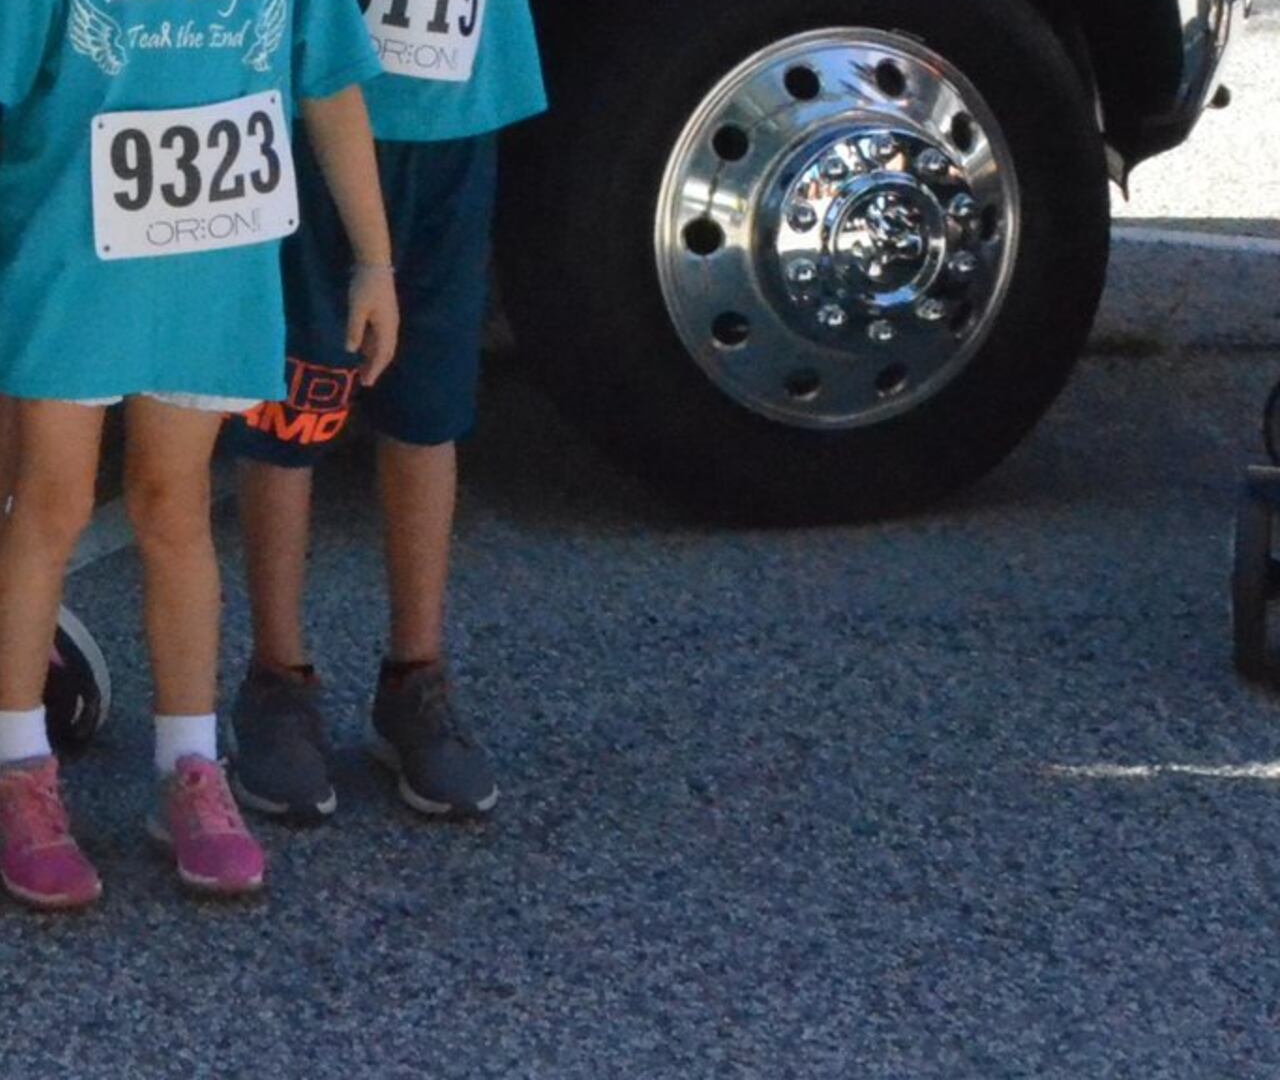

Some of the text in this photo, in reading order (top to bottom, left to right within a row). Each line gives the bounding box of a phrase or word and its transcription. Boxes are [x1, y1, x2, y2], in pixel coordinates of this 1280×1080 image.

[176, 19, 204, 48] the
[208, 19, 252, 48] End
[109, 110, 282, 212] 9323
